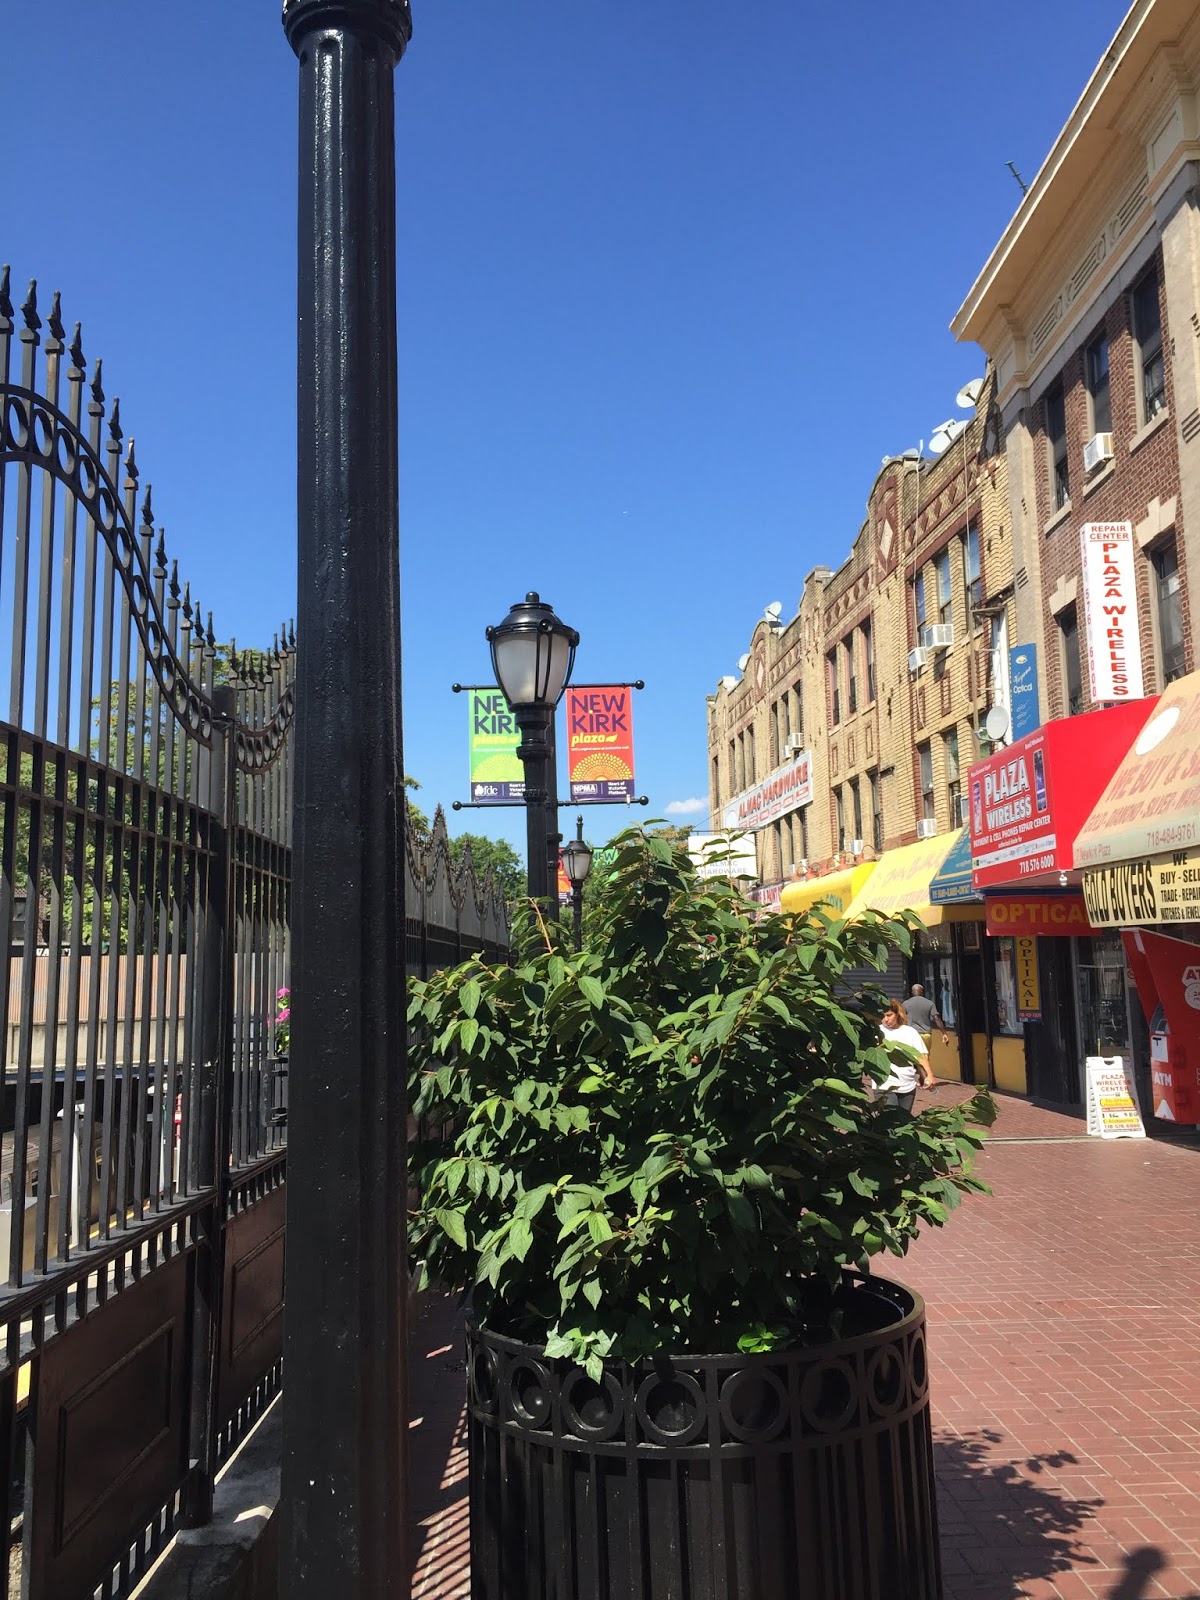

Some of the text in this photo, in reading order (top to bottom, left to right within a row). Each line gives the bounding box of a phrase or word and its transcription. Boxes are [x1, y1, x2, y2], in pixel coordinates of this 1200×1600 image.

[1089, 532, 1129, 540] CENTER
[1091, 525, 1126, 533] REPAIR
[1102, 542, 1129, 696] PLAZA WIRELESS
[1013, 683, 1033, 694] Optical
[474, 695, 515, 714] NE
[571, 693, 626, 714] NEW
[571, 713, 628, 733] KIRK
[571, 732, 605, 747] plaza
[983, 756, 1031, 808] PLAZA
[1127, 752, 1177, 796] BUY
[573, 784, 596, 793] NPMA
[739, 791, 761, 820] ALMAC
[762, 761, 808, 808] HARDWARE
[986, 794, 1032, 831] WIRELESS
[1033, 814, 1052, 827] CENTER
[1146, 822, 1196, 849] 718-484-9761
[1019, 854, 1055, 874] 718 576 6000
[1172, 852, 1188, 866] WE
[701, 867, 748, 875] HARDWARE
[974, 872, 979, 884] 6
[1160, 871, 1177, 885] BUY
[1084, 860, 1157, 923] GOLD BUYERS
[1160, 889, 1178, 903] TRADE
[991, 903, 1090, 923] OPTICA
[1019, 938, 1035, 1008] OPTICAL
[1154, 1072, 1172, 1087] ATM
